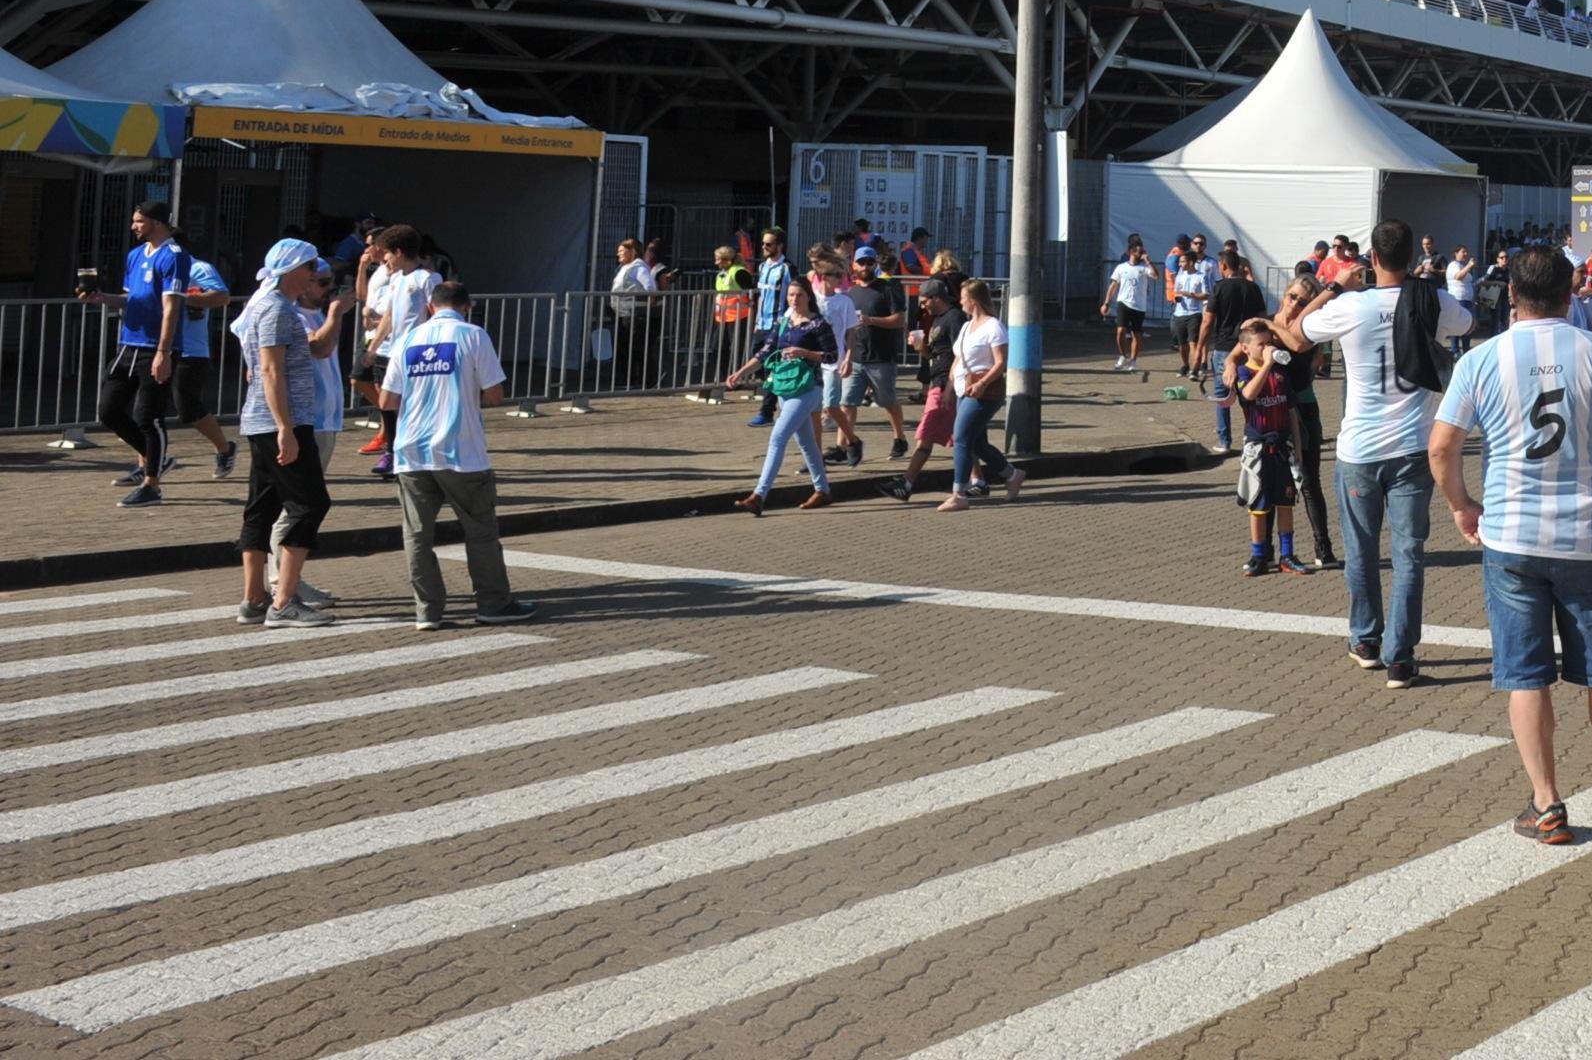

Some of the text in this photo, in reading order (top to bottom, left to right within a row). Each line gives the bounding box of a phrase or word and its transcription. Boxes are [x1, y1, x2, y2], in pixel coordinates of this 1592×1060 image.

[233, 119, 345, 136] ENTRADA DE MÍDIA
[378, 127, 471, 143] Entrada de Medios
[501, 135, 573, 149] Media Entrance
[809, 148, 825, 184] 6
[1529, 364, 1564, 377] ENZO
[1525, 387, 1567, 460] 5
